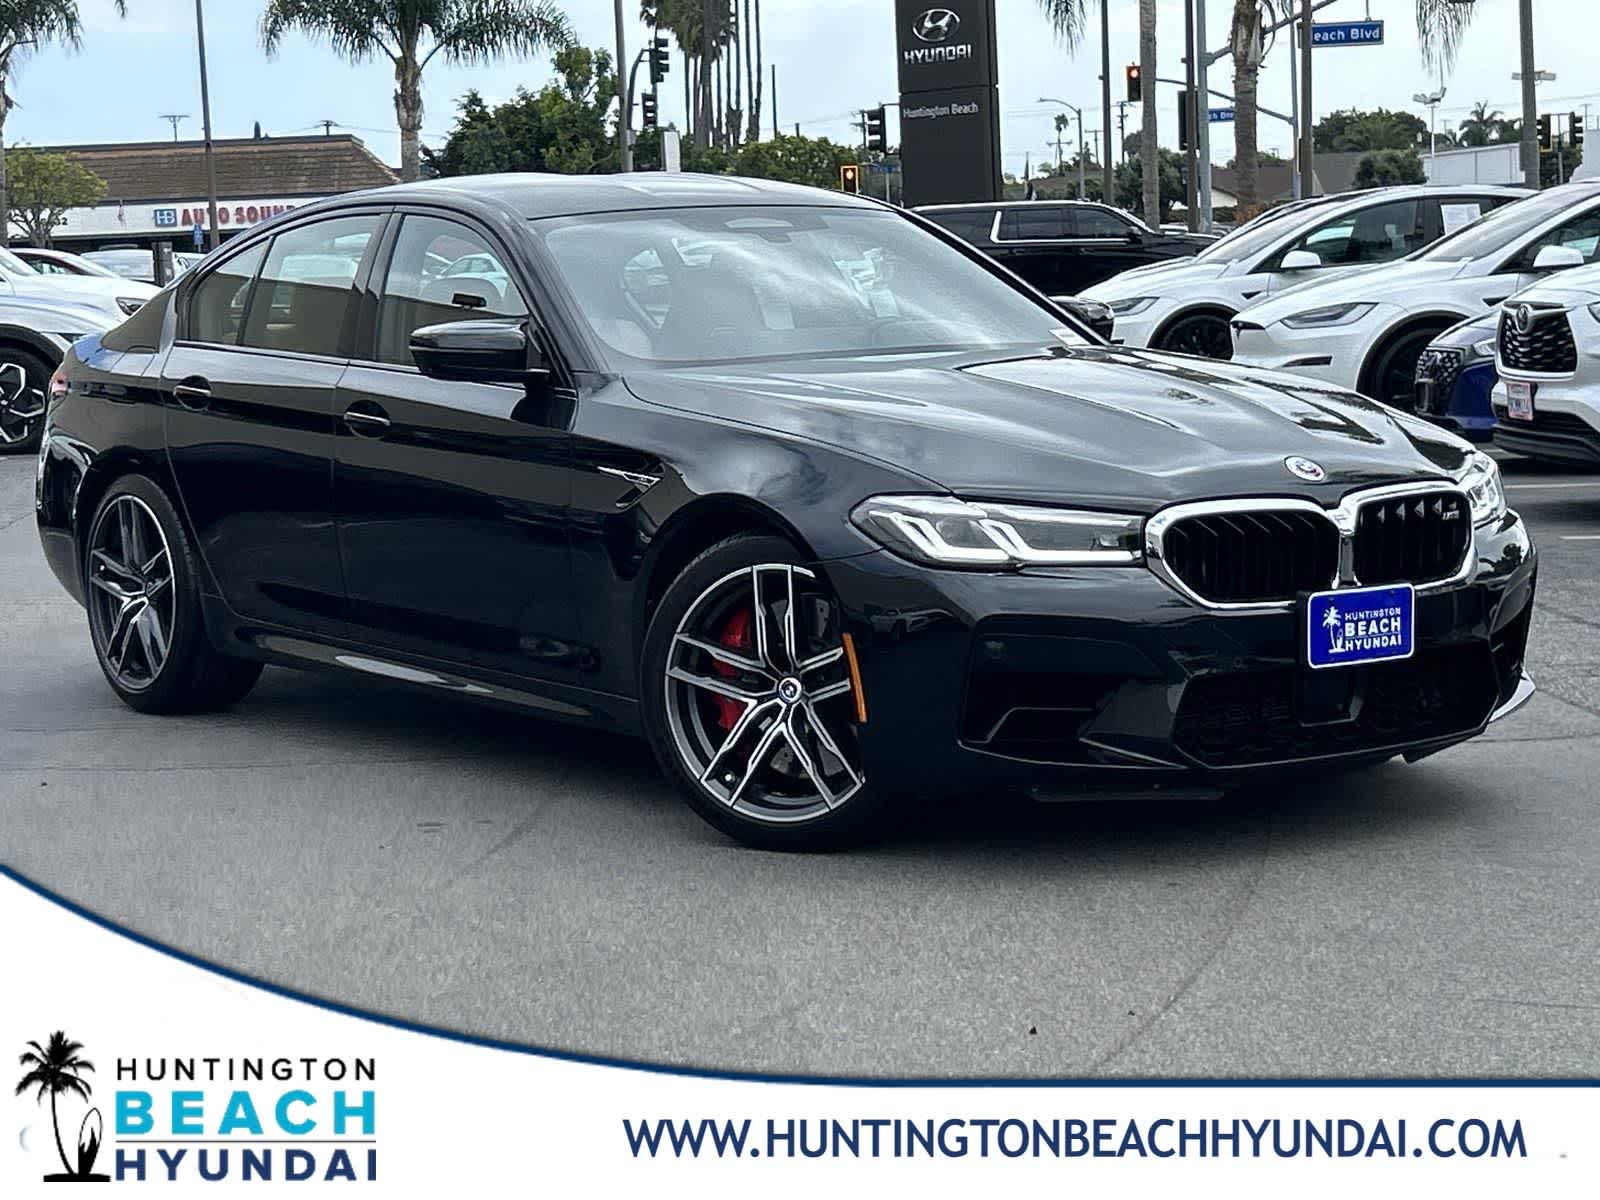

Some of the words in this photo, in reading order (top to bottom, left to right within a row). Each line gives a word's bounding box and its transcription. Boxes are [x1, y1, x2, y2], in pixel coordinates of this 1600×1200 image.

[1314, 29, 1345, 41] each
[1350, 27, 1380, 40] Blvd
[903, 44, 972, 63] HYUNDAI
[903, 106, 950, 119] Huntington
[951, 102, 978, 114] Beach
[1344, 607, 1402, 621] HUNTINGTON
[1345, 617, 1401, 637] BEACH
[1345, 634, 1402, 651] HYUNDAI
